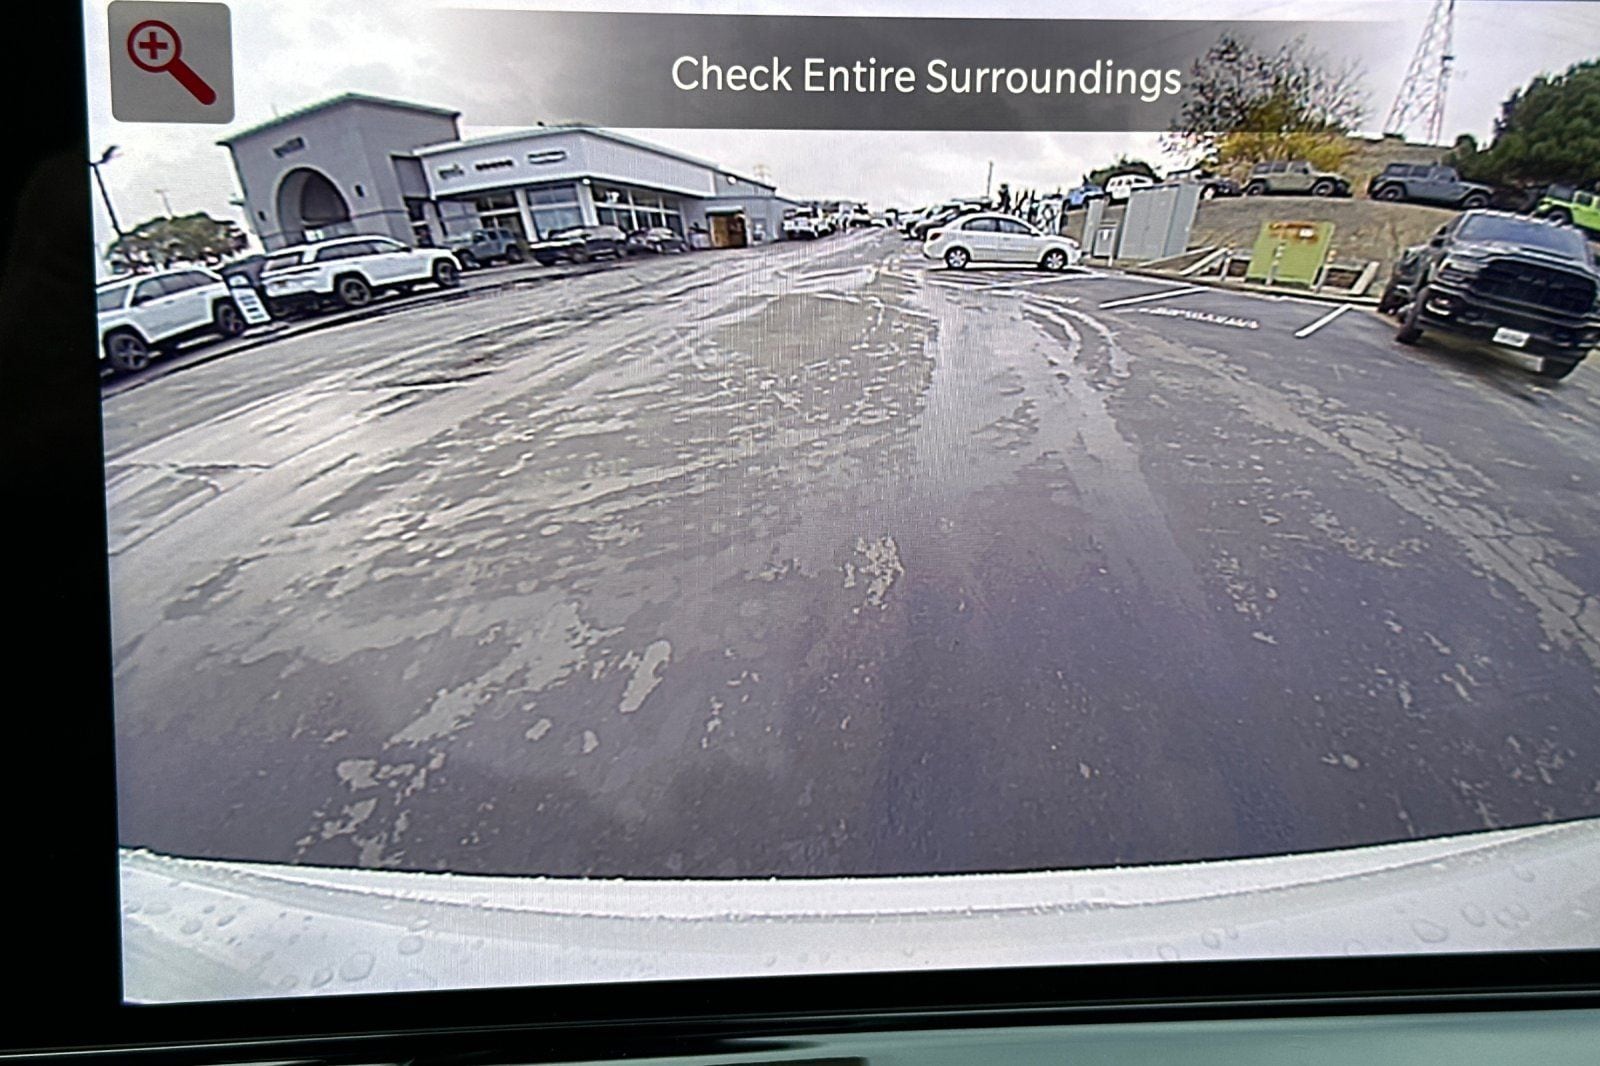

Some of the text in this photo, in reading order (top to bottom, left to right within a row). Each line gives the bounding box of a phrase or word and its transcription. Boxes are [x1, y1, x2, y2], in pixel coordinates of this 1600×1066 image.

[671, 55, 1182, 103] Check Entire Surroundings
